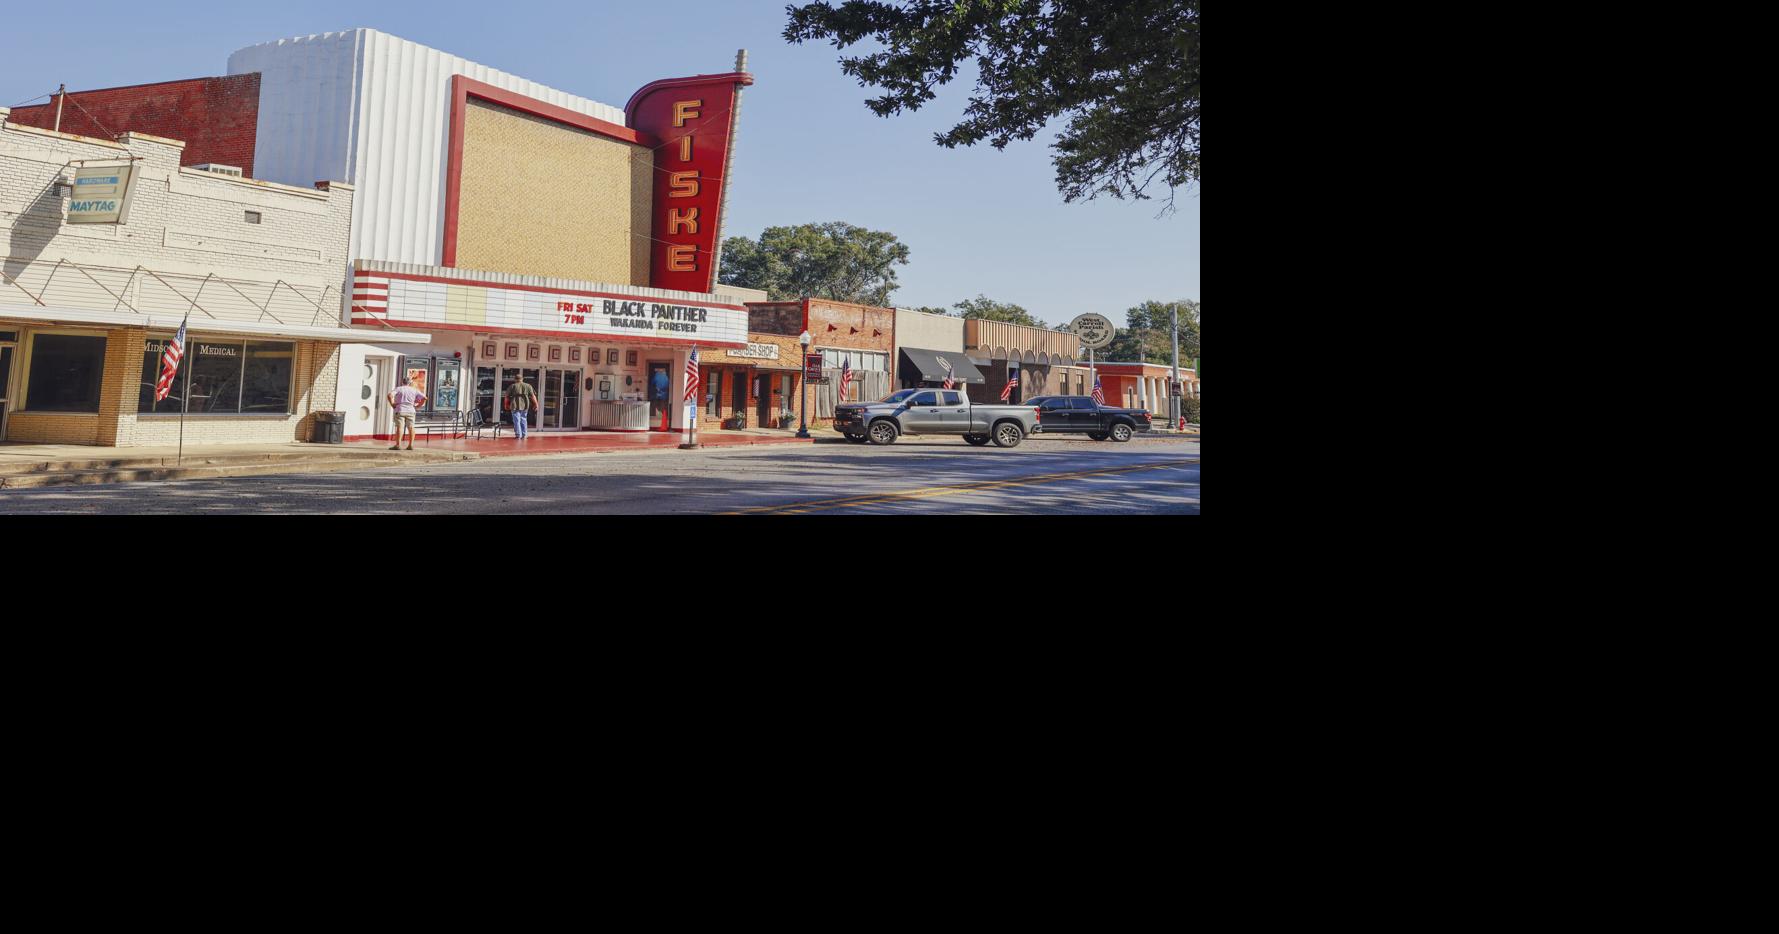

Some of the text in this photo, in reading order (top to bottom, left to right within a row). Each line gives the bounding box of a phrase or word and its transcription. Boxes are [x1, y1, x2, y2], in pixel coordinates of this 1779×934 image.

[668, 100, 701, 271] FISKE
[69, 200, 115, 212] MAYTAG
[557, 301, 593, 314] FRI SAT
[602, 300, 707, 323] BLACK PANTHER
[610, 317, 697, 333] WAKANDA FOREVER
[145, 342, 168, 352] MIDSO
[758, 345, 774, 357] SHOP
